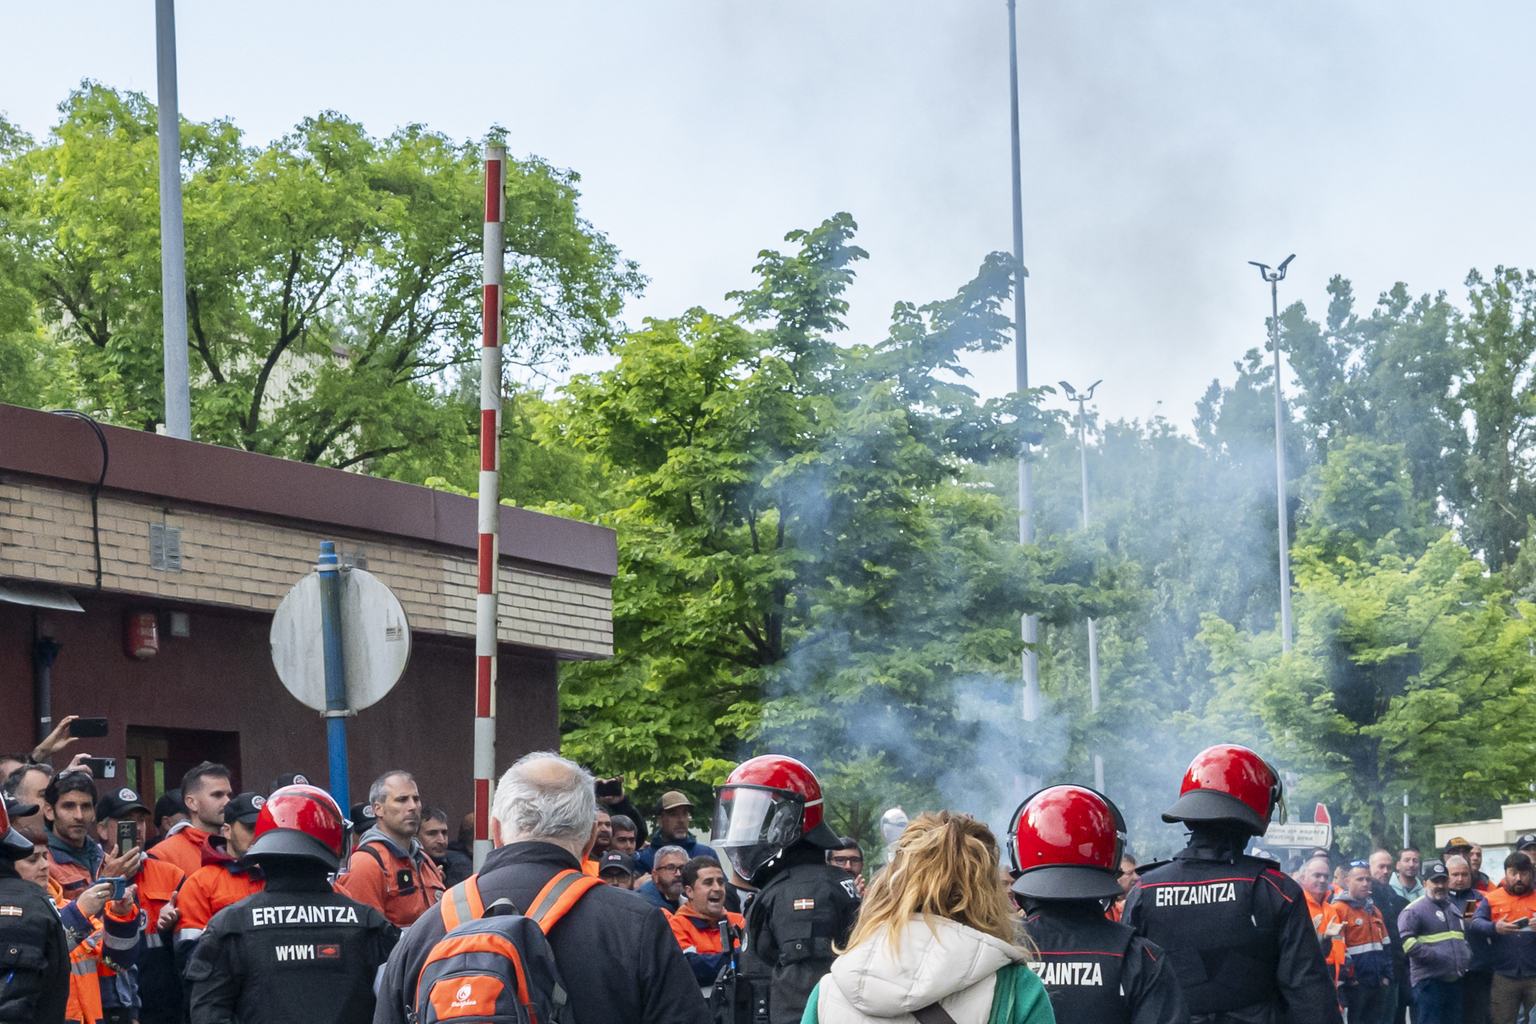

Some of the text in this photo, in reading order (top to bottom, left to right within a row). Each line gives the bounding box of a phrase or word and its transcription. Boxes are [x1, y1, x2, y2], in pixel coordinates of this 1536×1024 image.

[1155, 883, 1236, 907] ERTZAINTZA
[252, 905, 359, 926] ERTZAINTZA
[275, 944, 315, 961] W1W1
